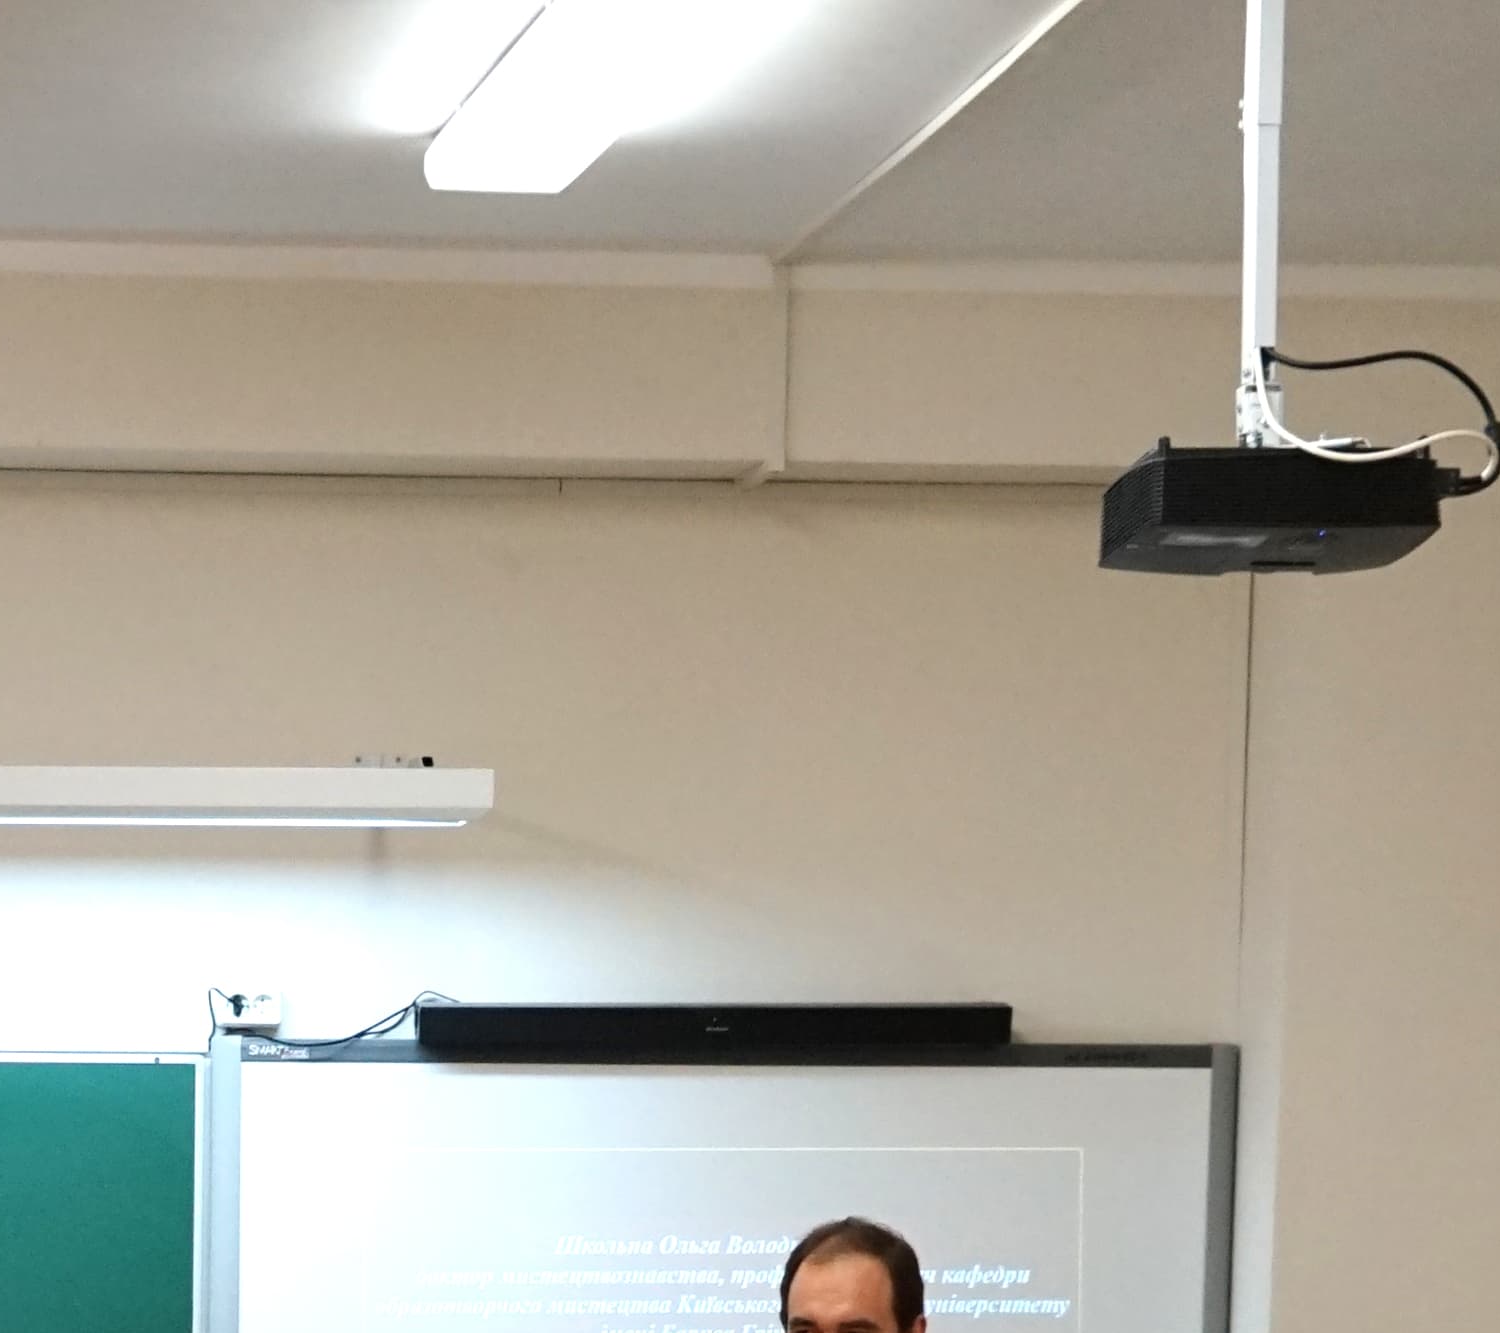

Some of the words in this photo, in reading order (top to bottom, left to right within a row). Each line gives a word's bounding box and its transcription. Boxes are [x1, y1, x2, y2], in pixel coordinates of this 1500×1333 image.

[554, 1234, 654, 1255] Школьна
[659, 1234, 721, 1256] Ольга
[730, 1263, 785, 1289] проф
[941, 1262, 1032, 1288] кафедри
[546, 1298, 672, 1317] мистецтва
